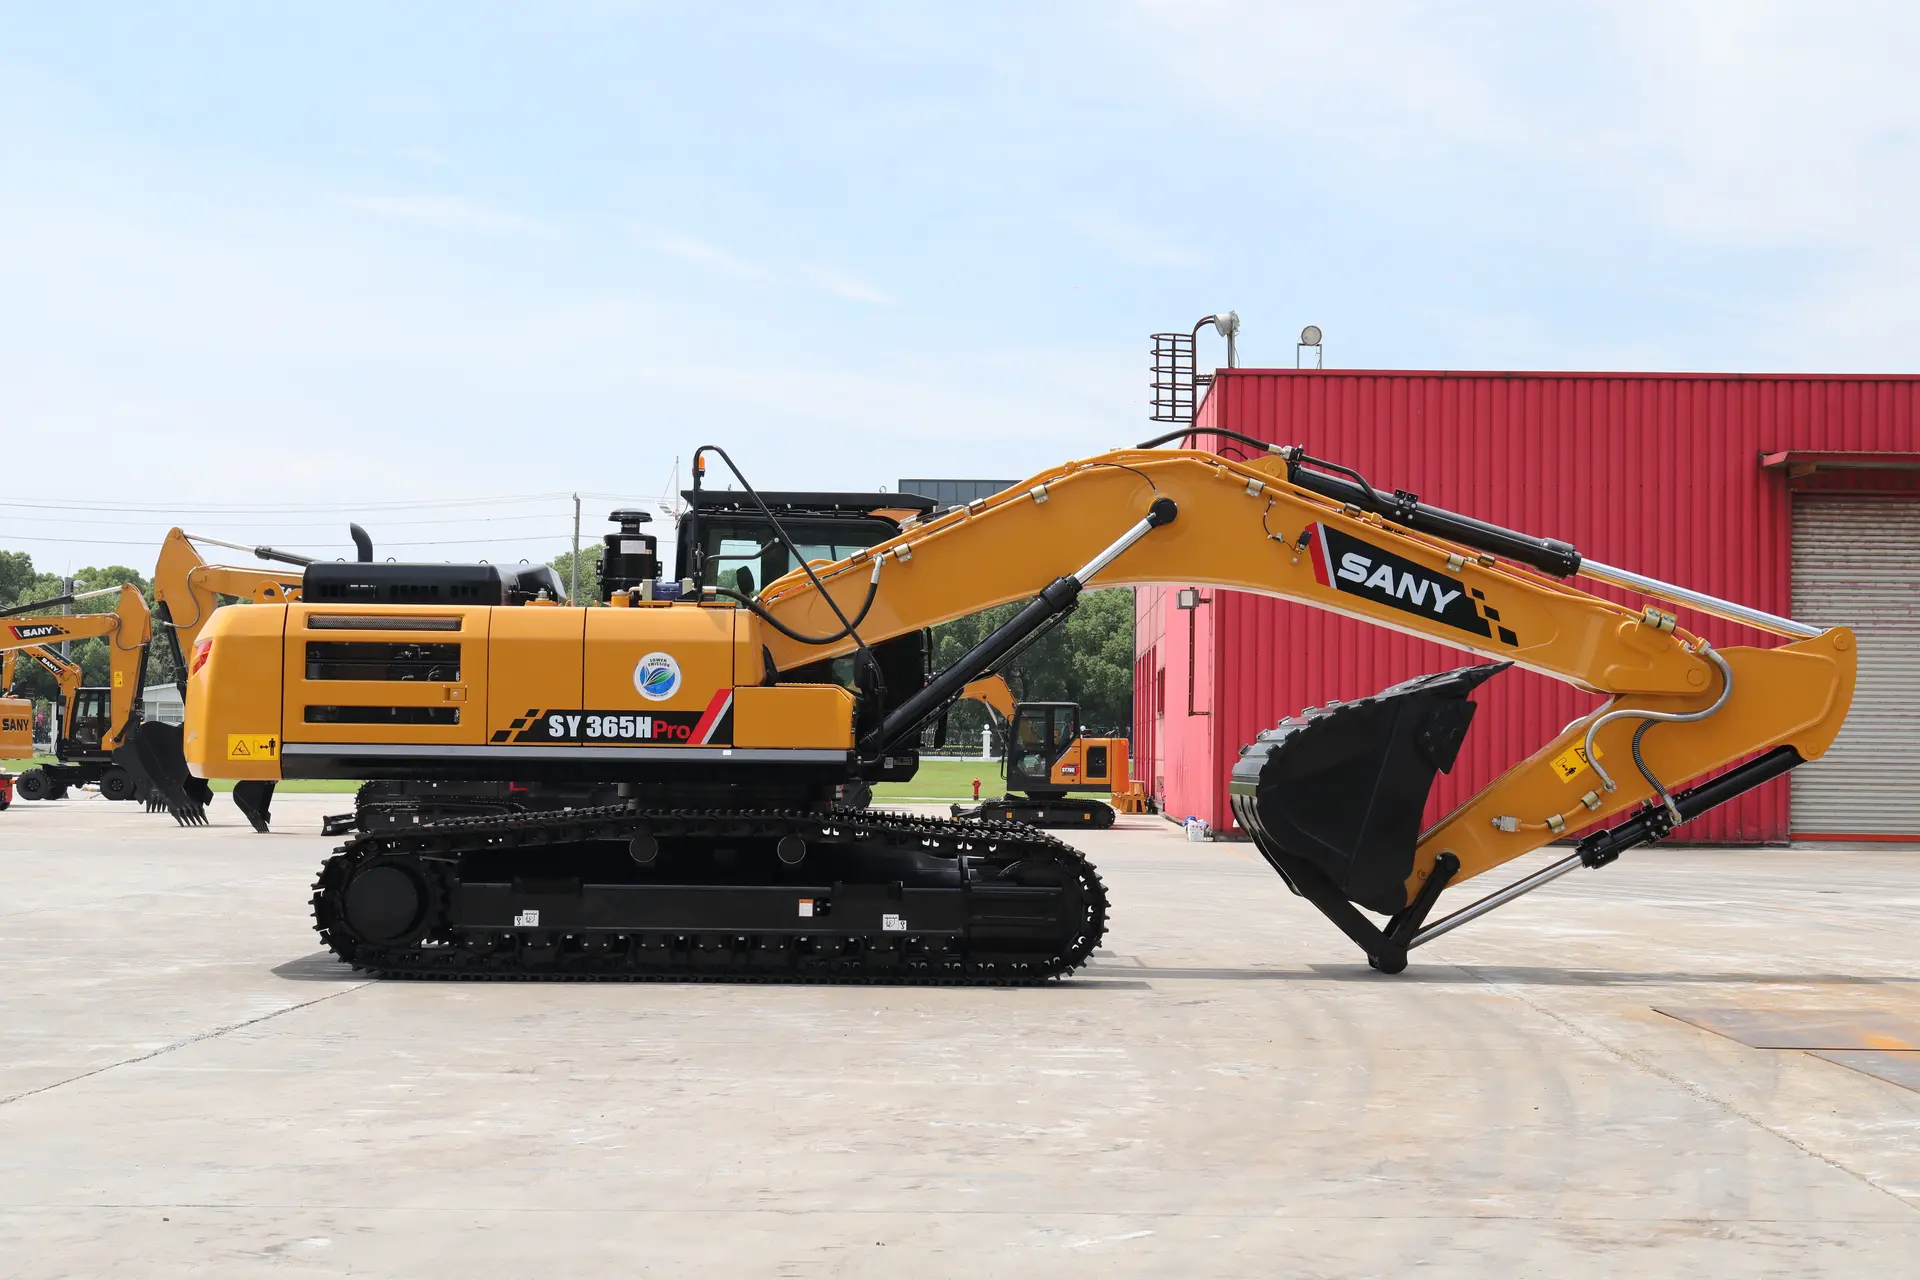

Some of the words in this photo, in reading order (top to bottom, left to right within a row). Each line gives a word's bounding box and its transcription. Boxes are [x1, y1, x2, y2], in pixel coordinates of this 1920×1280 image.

[1337, 552, 1461, 613] SANY
[22, 626, 53, 637] SANY
[41, 657, 59, 672] SANY
[2, 718, 29, 731] SANY
[548, 715, 582, 737] SY
